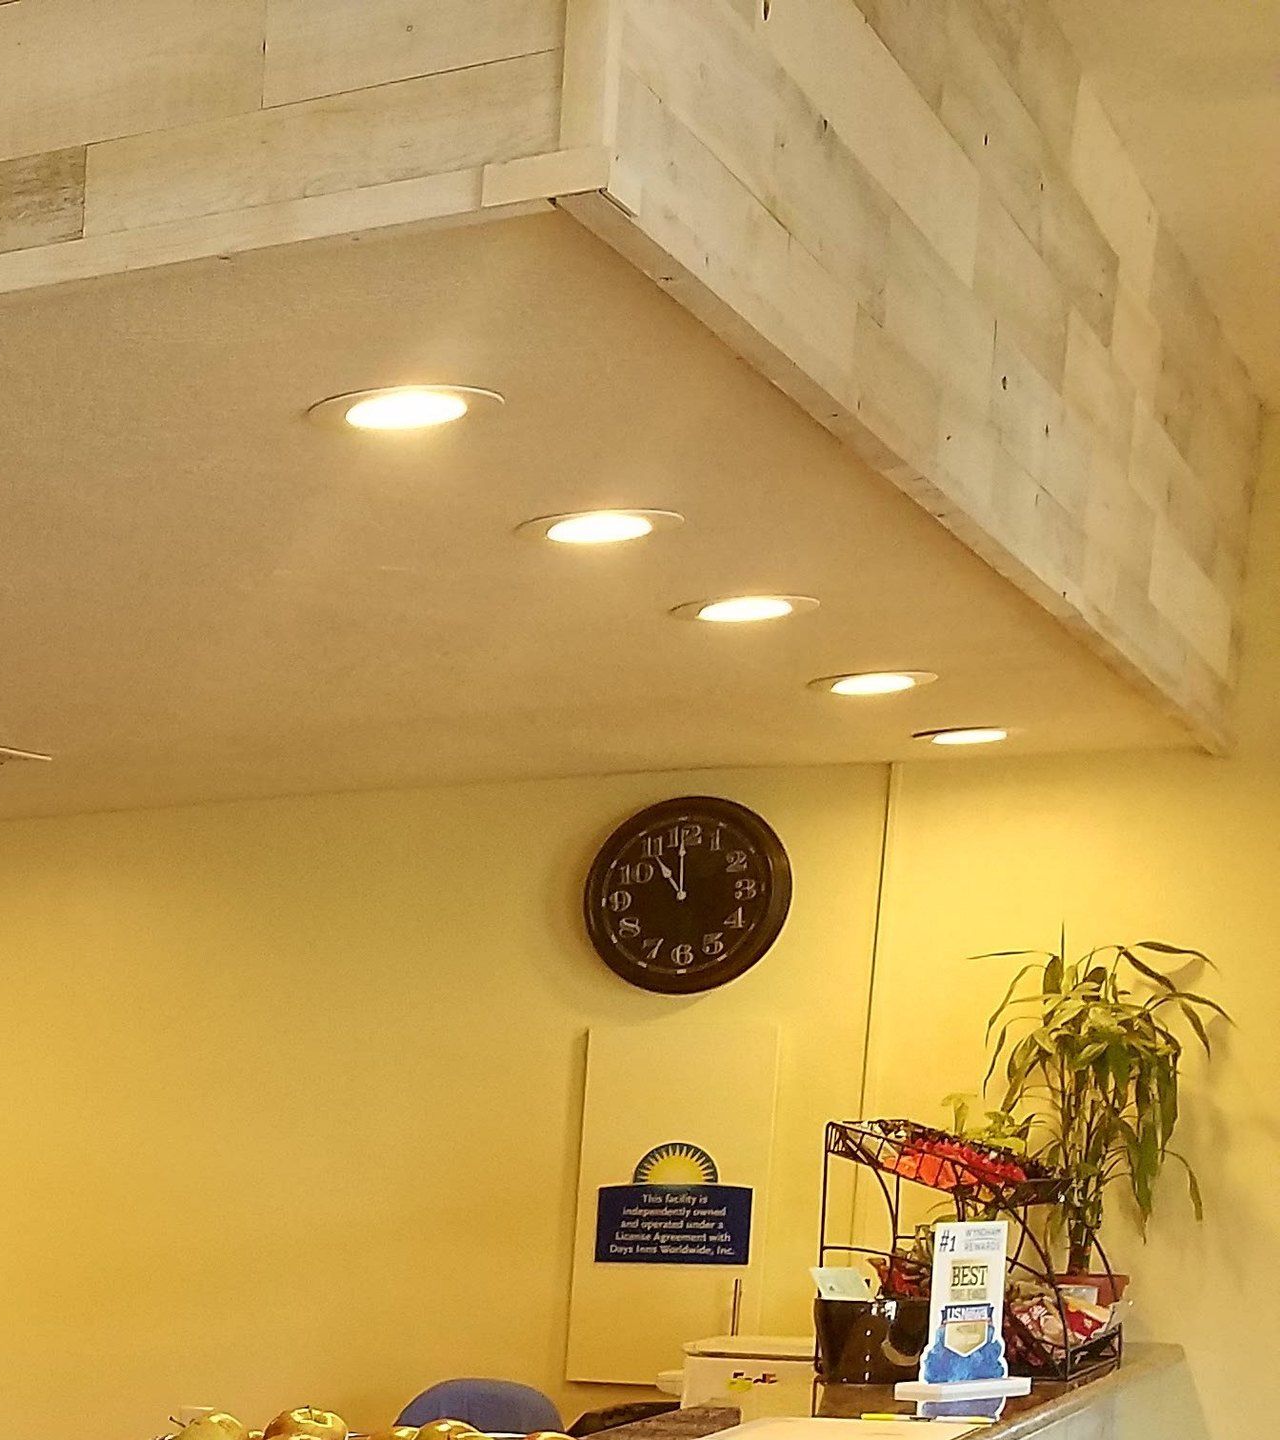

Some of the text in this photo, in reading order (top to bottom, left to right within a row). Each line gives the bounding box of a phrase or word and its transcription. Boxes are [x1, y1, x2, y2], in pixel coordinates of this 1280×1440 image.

[640, 836, 663, 858] 11
[667, 824, 702, 848] 12
[710, 828, 722, 851] 1
[725, 850, 748, 873] 2
[620, 862, 654, 885] 10
[734, 878, 757, 900] 3
[608, 890, 632, 912] 9
[618, 916, 641, 938] 8
[723, 907, 746, 929] 4
[643, 938, 664, 959] 7
[670, 943, 694, 966] 6
[702, 932, 724, 955] 5
[643, 1193, 708, 1206] This facility is
[622, 1205, 727, 1218] independently owned
[620, 1219, 640, 1229] and
[641, 1220, 684, 1230] operated
[686, 1219, 715, 1229] under
[615, 1231, 731, 1244] License Agreement with
[939, 1228, 956, 1252] #1
[609, 1244, 634, 1255] Days
[716, 1245, 735, 1255] Inc.
[951, 1265, 988, 1287] BEST
